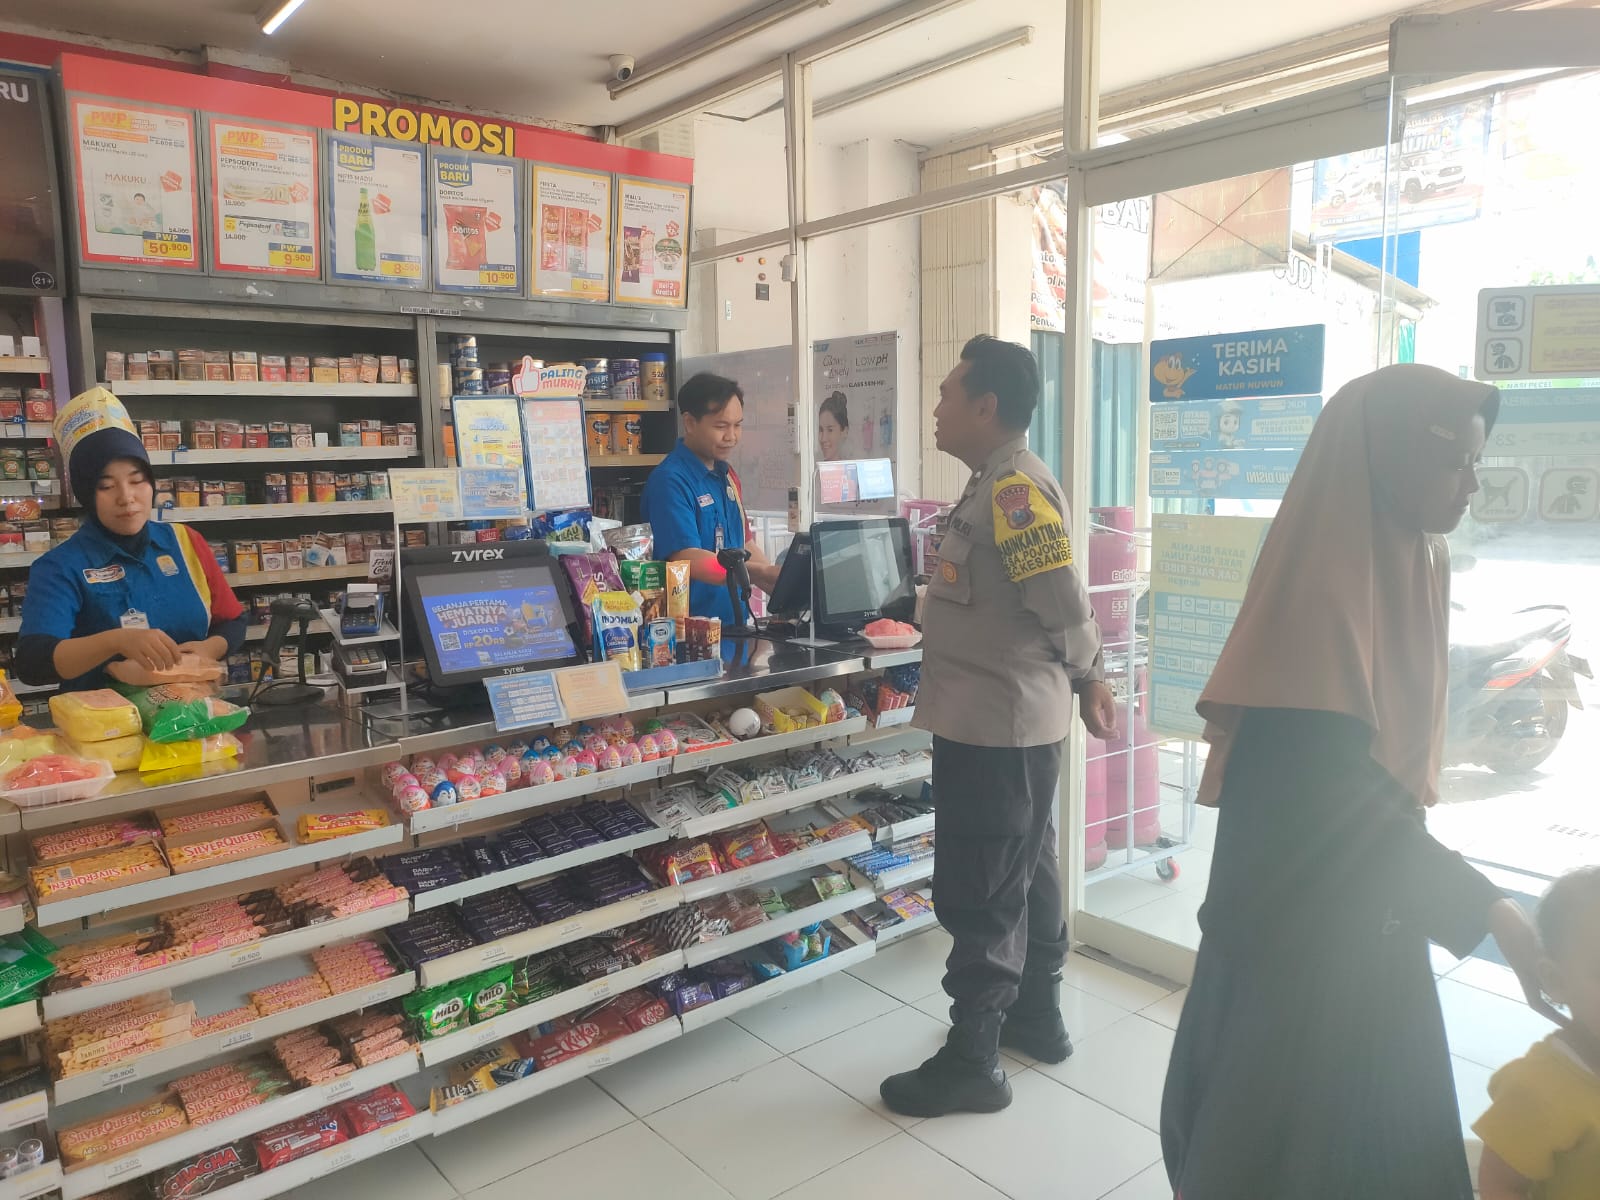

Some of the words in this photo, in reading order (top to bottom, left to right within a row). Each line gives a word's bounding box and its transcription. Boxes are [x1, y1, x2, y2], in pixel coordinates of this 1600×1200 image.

[91, 111, 128, 124] PWP
[335, 98, 515, 158] PROMOSI
[227, 131, 259, 143] PWP
[83, 139, 117, 149] MAKUKU
[339, 145, 372, 156] PRODUK
[220, 157, 258, 167] PEPSODENT
[339, 154, 372, 167] BARU
[439, 162, 469, 172] PRODUK
[105, 173, 146, 185] MAKUKU
[440, 171, 470, 183] BARU
[440, 189, 464, 197] DORITOS
[155, 233, 178, 241] PWP
[452, 225, 480, 236] Doritos
[1212, 338, 1289, 359] TERIMA
[1218, 356, 1281, 377] KASIH
[541, 368, 583, 381] PALING
[542, 378, 583, 390] MURAH
[1216, 381, 1246, 391] MATUR
[1247, 379, 1284, 389] NUWUN
[373, 558, 392, 567] Fresh
[432, 602, 470, 614] BELANJA
[470, 599, 508, 609] PERTAMA
[438, 606, 507, 622] HEMATNYA
[601, 615, 639, 625] INDOMILK
[452, 617, 499, 630] JUARA!
[42, 831, 116, 855] SILVERQUEEN
[184, 831, 264, 859] SILVERQUEEN
[51, 868, 121, 893] SILVERQUEEN
[94, 964, 139, 985] SILVERQUEEN
[476, 985, 504, 1004] MILO
[434, 1003, 461, 1021] MILO
[106, 1013, 159, 1038] SILVERQUEEN
[561, 1024, 599, 1051] KitKat
[185, 1084, 251, 1116] SILVERQUEEN
[68, 1113, 141, 1145] SILVERQUEEN
[108, 1116, 181, 1149] SILVERQUEEN
